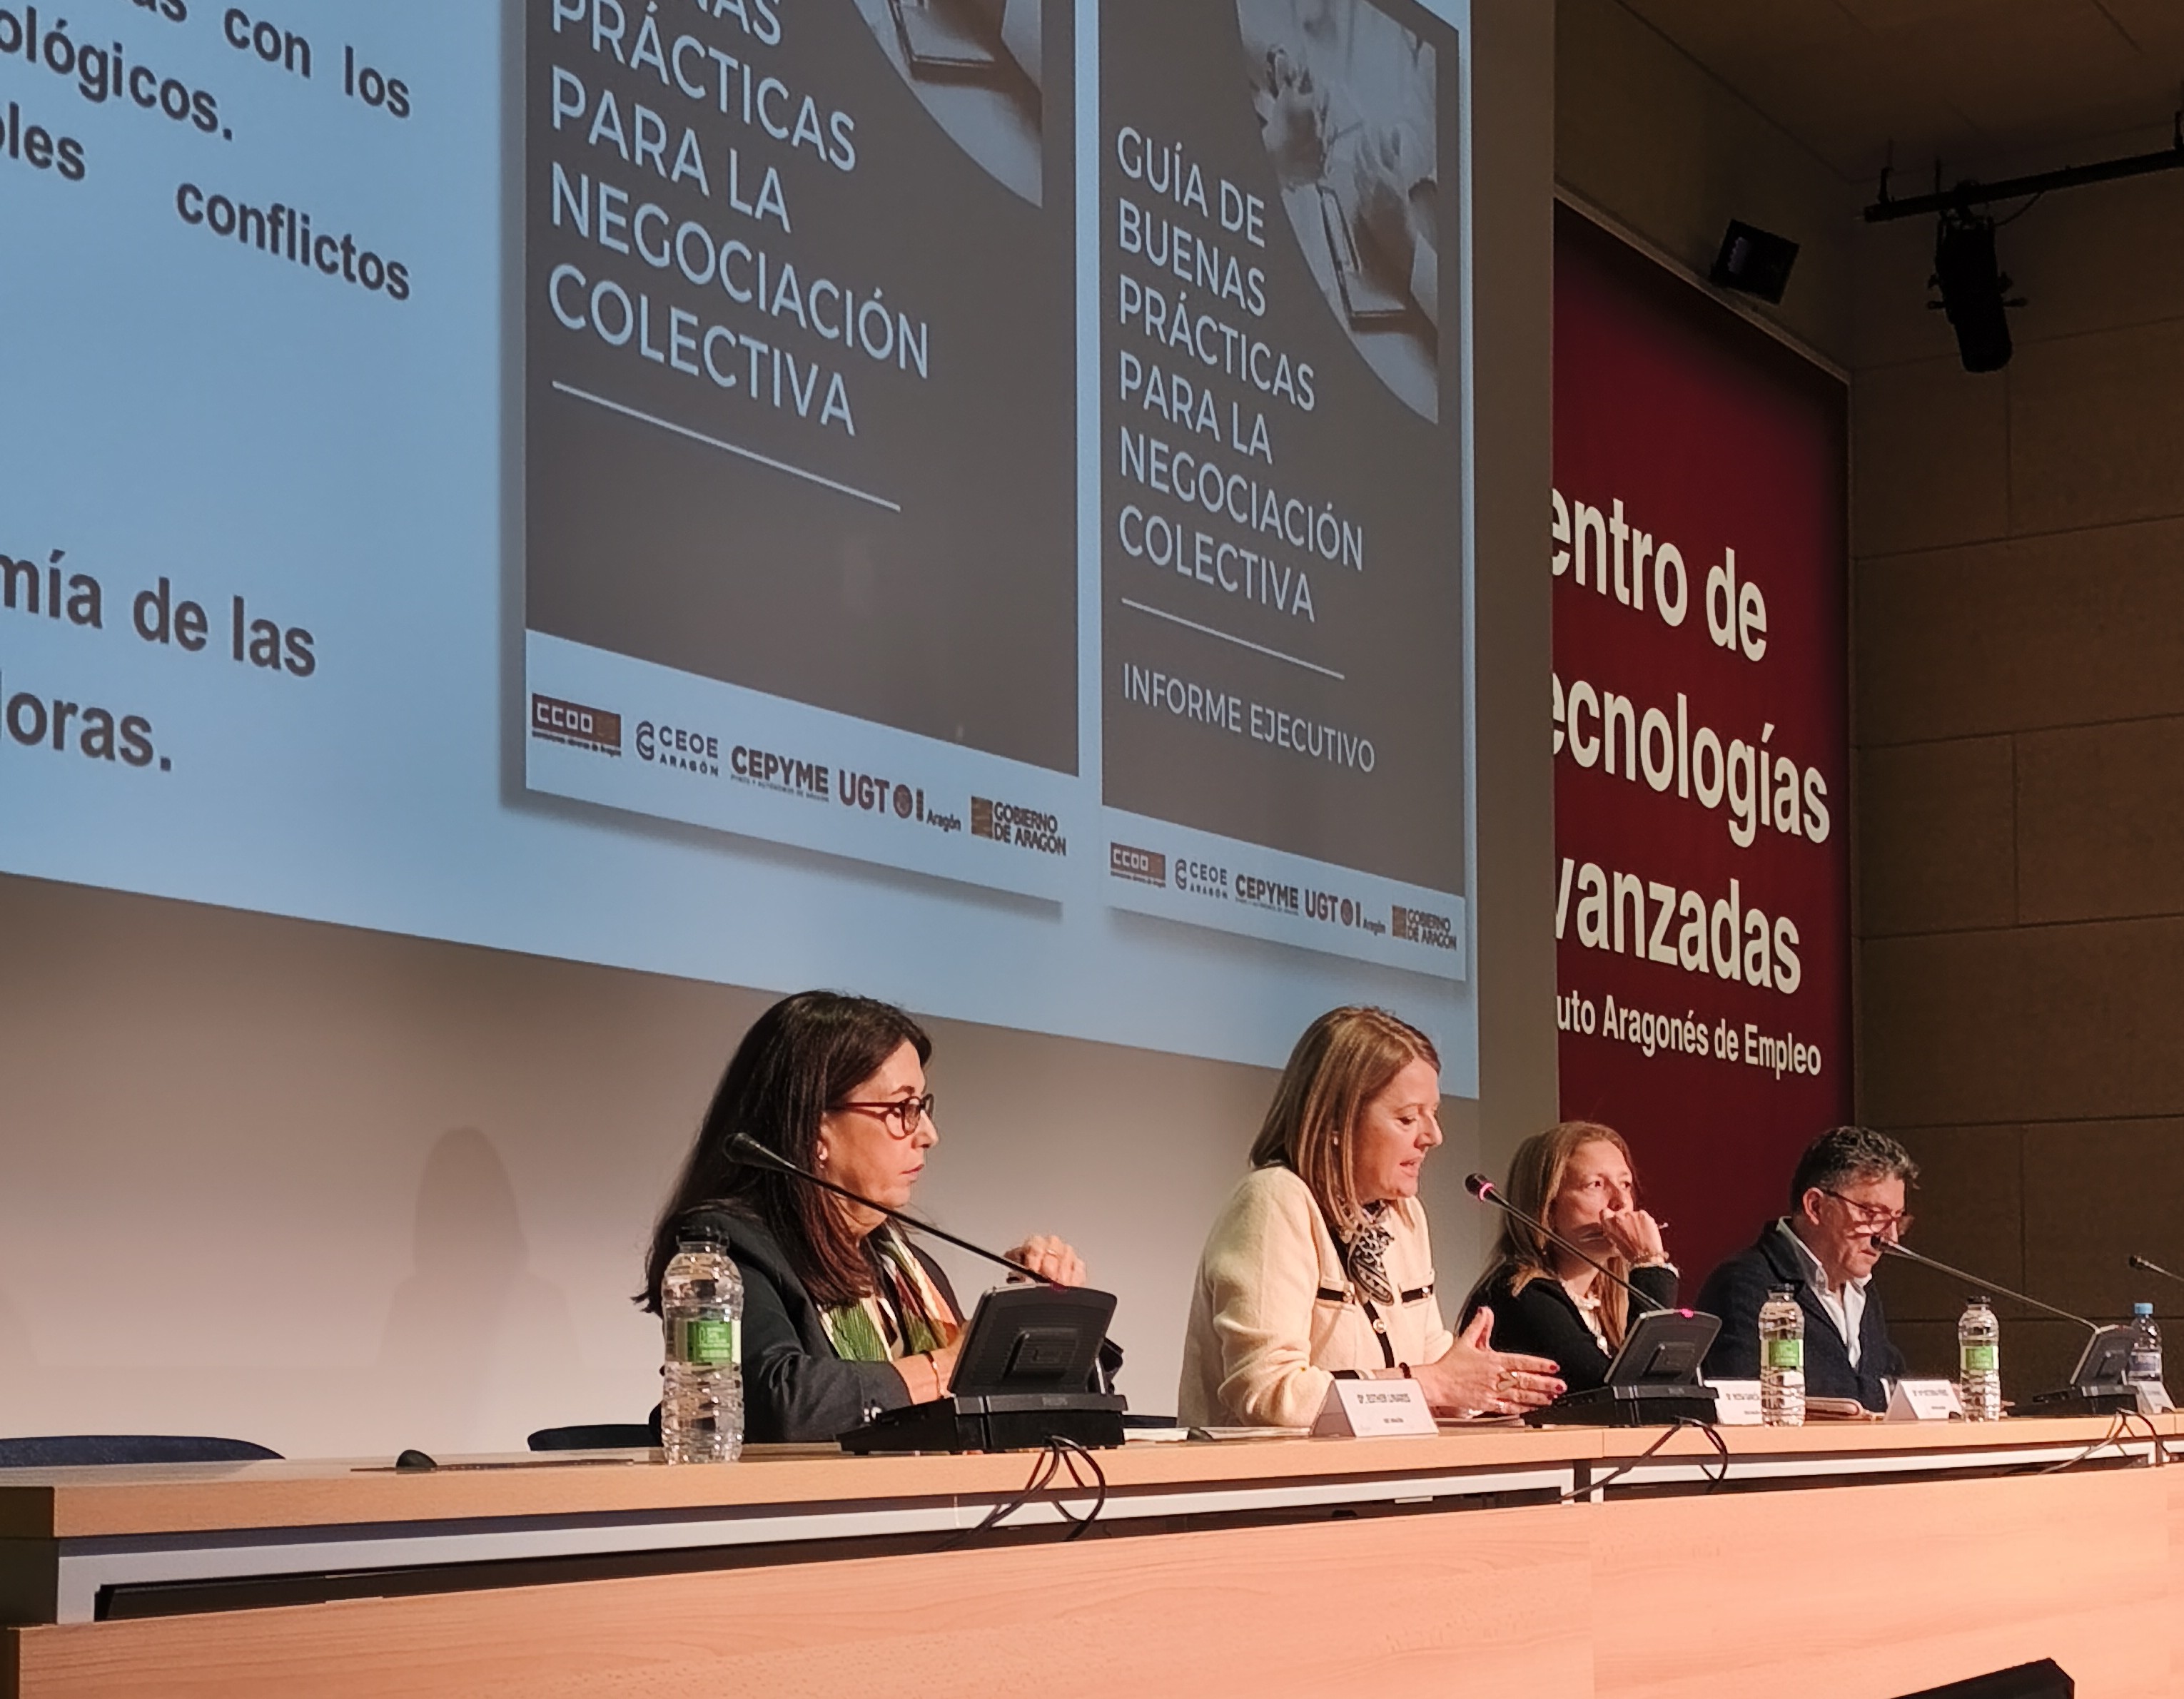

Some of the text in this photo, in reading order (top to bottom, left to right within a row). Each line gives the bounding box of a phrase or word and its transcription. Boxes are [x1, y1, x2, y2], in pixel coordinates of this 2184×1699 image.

[224, 8, 310, 79] con
[345, 45, 410, 118] los
[552, 0, 856, 171] PRÁCTICAS
[0, 101, 86, 181] les
[552, 66, 791, 233] PARA LA
[1118, 126, 1265, 248] GUÍA DE
[176, 183, 410, 300] conflictos
[552, 161, 927, 379] NEGOCIACIÓN
[1120, 198, 1265, 316] BUENAS
[550, 264, 856, 437] COLECTIVA
[1120, 274, 1315, 411] PRÁCTICAS
[1120, 350, 1273, 465] PARA LA
[1121, 426, 1362, 571] NEGOCIACIÓN
[1120, 505, 1315, 623] COLECTIVA
[1707, 547, 1767, 661] de
[133, 577, 208, 651] de
[233, 594, 315, 677] las
[0, 669, 171, 771] oras.
[659, 726, 718, 759] CEOE
[732, 745, 829, 794] CEPYME
[1124, 663, 1375, 772] INFORME EJECUTIVO
[839, 769, 890, 813] UGT
[994, 801, 1058, 833] GOBIERNO
[994, 822, 1011, 843] DE
[1189, 862, 1228, 886] CEOE
[1235, 874, 1299, 910] CEPYME
[1304, 889, 1339, 923] UGT
[1602, 995, 1709, 1058] Aragonés
[1714, 1018, 1739, 1062] de
[1744, 1023, 1822, 1080] Empleo
